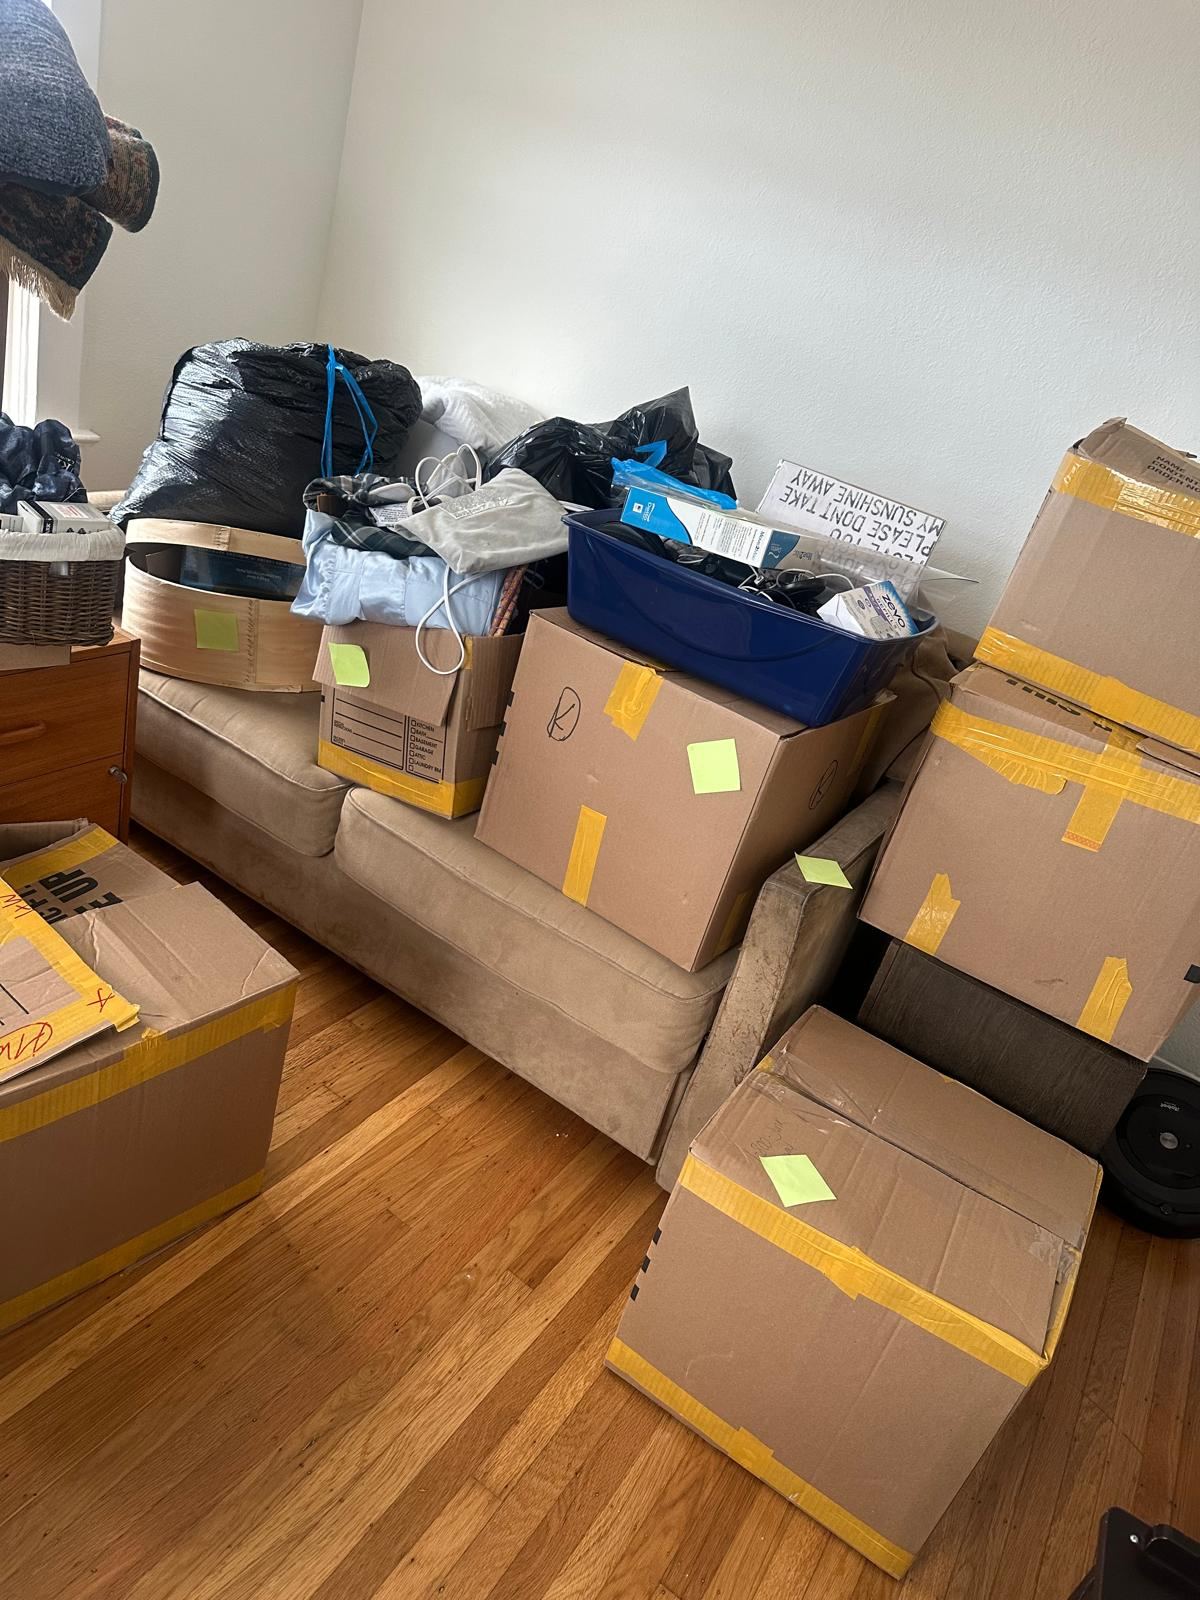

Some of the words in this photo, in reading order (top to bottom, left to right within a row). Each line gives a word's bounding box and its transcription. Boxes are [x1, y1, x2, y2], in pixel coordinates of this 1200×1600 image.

[790, 469, 835, 496] AWAY
[779, 485, 818, 515] TAKE
[833, 485, 917, 527] SUNSHINE
[819, 502, 867, 532] DONT
[917, 516, 945, 536] MY
[867, 519, 936, 557] PLEASE
[38, 869, 99, 903] UP
